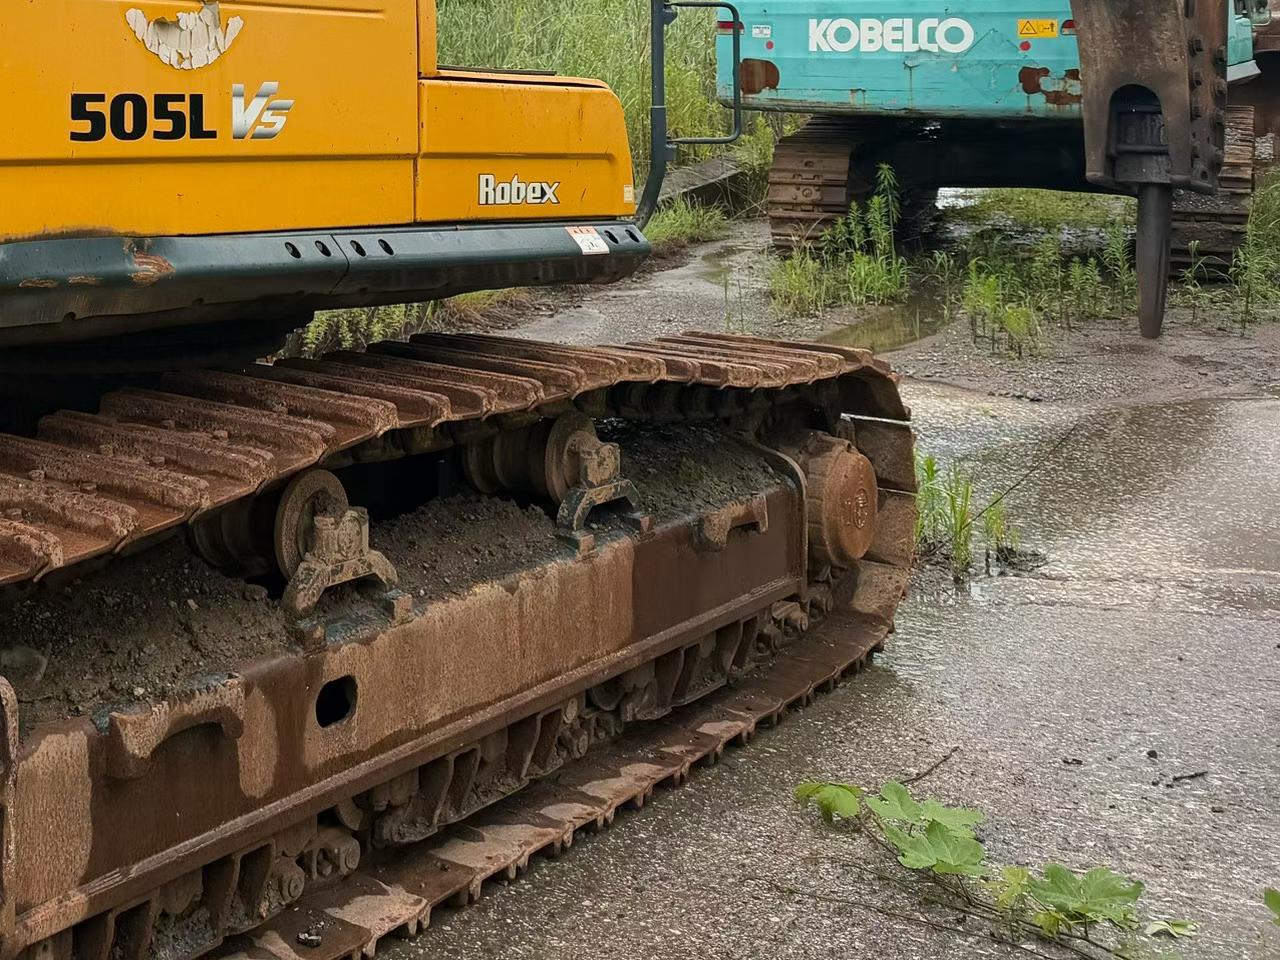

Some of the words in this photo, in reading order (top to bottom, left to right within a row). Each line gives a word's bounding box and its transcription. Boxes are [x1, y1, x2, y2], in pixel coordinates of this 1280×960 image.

[808, 18, 974, 54] KOBELCO
[70, 93, 217, 141] 505L
[478, 174, 560, 205] Robex
